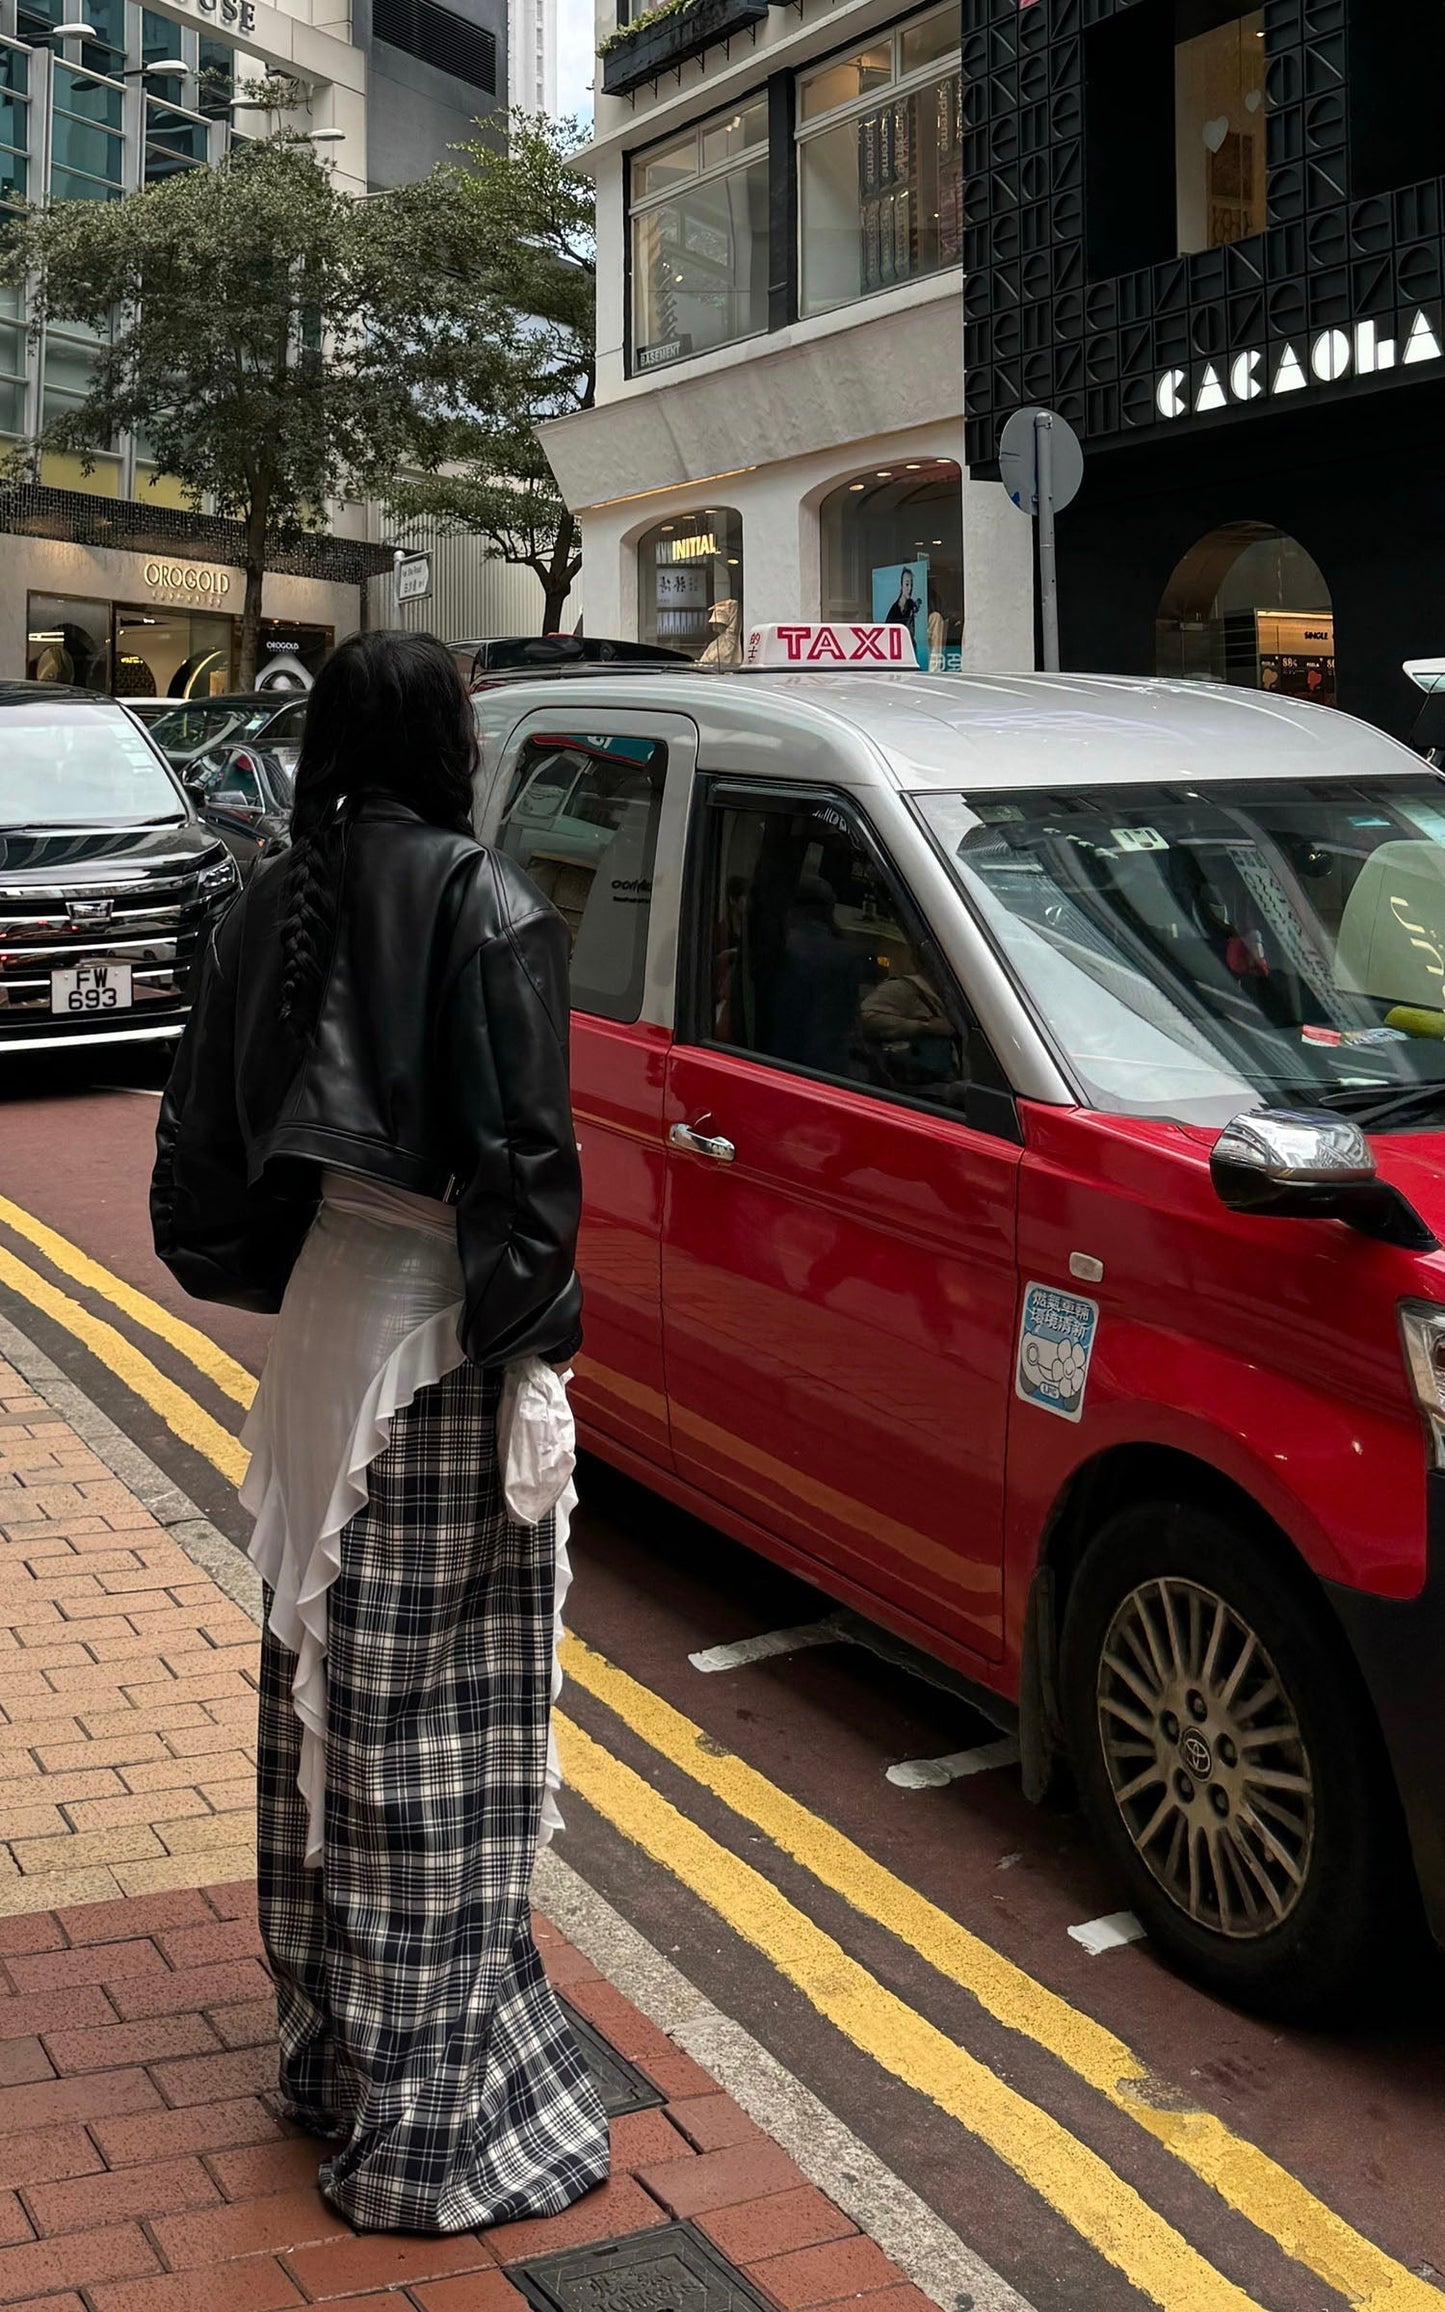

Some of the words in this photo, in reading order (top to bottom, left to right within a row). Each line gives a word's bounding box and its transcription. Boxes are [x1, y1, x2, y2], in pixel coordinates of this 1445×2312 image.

[940, 80, 950, 152] Supreme
[641, 344, 680, 366] BASEMENT
[672, 533, 716, 561] INITIAL
[144, 563, 230, 594] OROGOLD
[266, 641, 299, 650] OROGOLD
[777, 626, 903, 660] TAXI
[77, 968, 107, 989] FW
[68, 988, 117, 1010] 693
